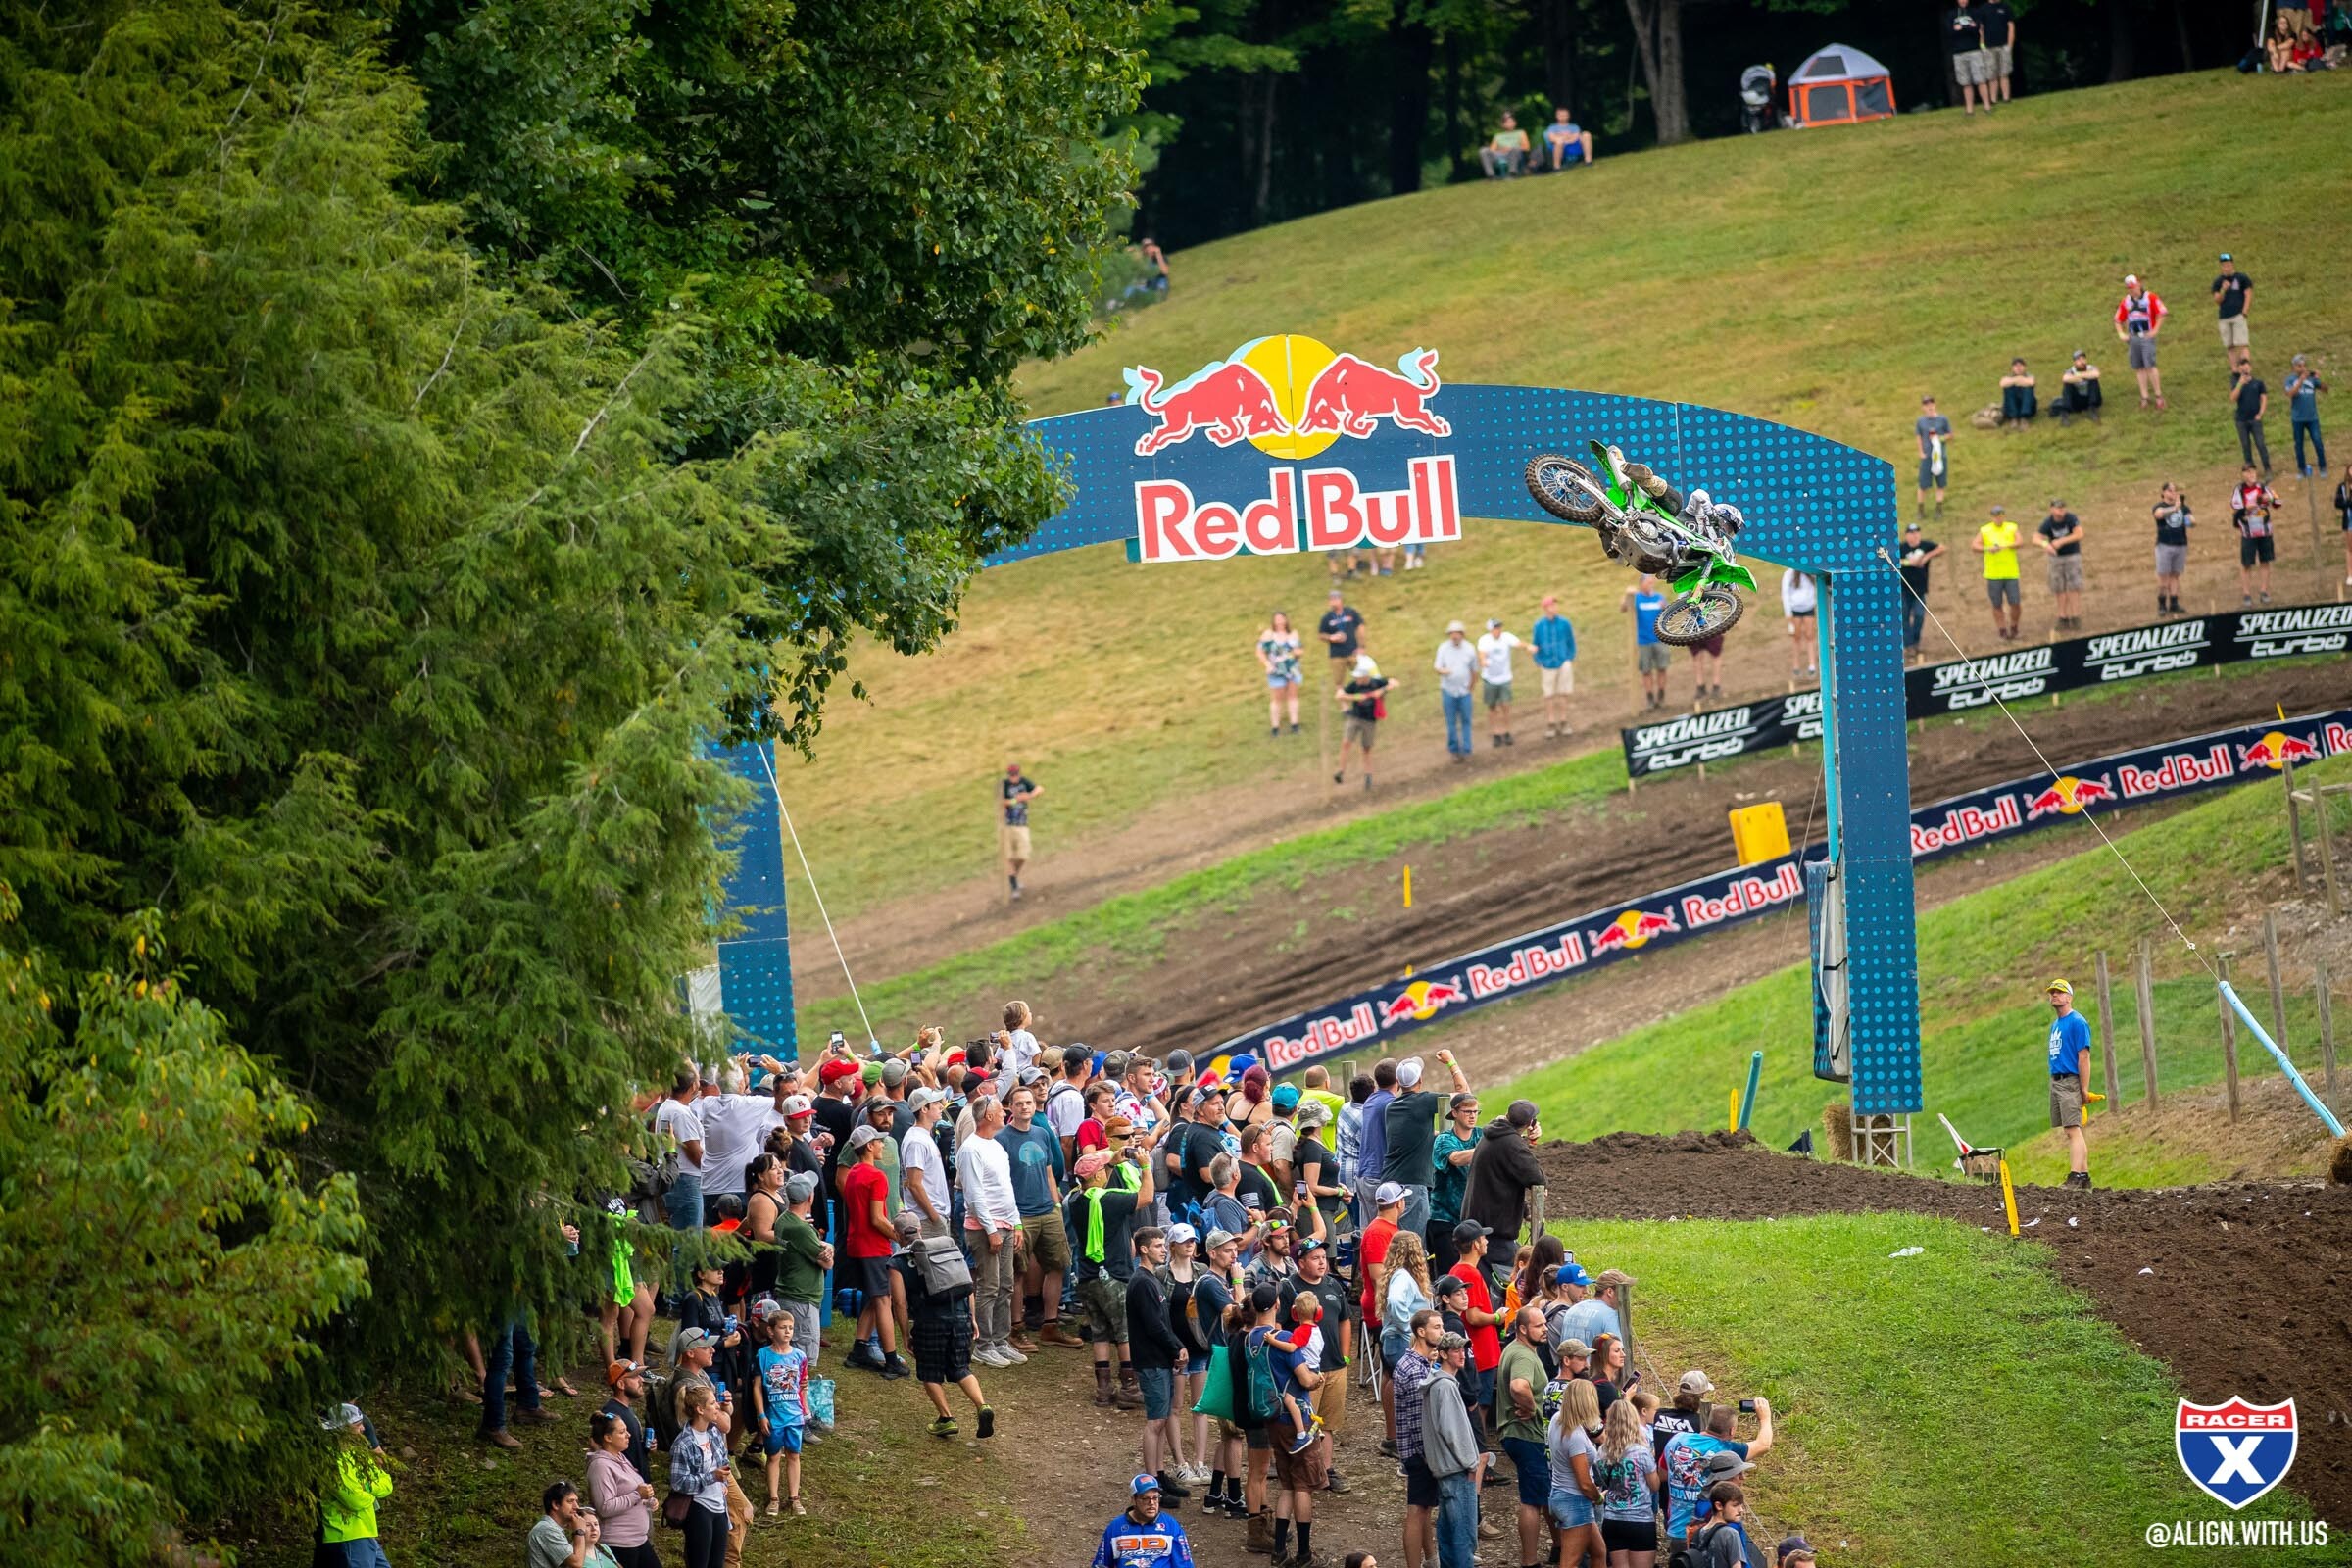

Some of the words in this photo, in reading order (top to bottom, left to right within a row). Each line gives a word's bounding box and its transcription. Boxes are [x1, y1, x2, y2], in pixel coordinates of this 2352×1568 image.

[1139, 470, 1296, 561] Red
[1306, 459, 1458, 547] Bull
[2085, 620, 2205, 661] SPECIALIZED
[2250, 633, 2347, 658] turbo
[1933, 647, 2052, 689] SPECIALIZED
[2101, 649, 2198, 681] turbo
[1948, 677, 2046, 710] turbo
[1634, 707, 1750, 751] SPECIALIZED
[1648, 736, 1745, 771] turbo
[2118, 756, 2179, 798] Red
[2174, 744, 2234, 785] Bull
[1959, 794, 2021, 839] Bull
[1682, 882, 1745, 929] Red
[1741, 862, 1804, 910] Bull
[1467, 950, 1529, 998] Red
[1526, 931, 1586, 977] Bull
[1265, 1022, 1324, 1070] Red
[1321, 1002, 1378, 1049] Bull
[1116, 1537, 1167, 1550] 3D
